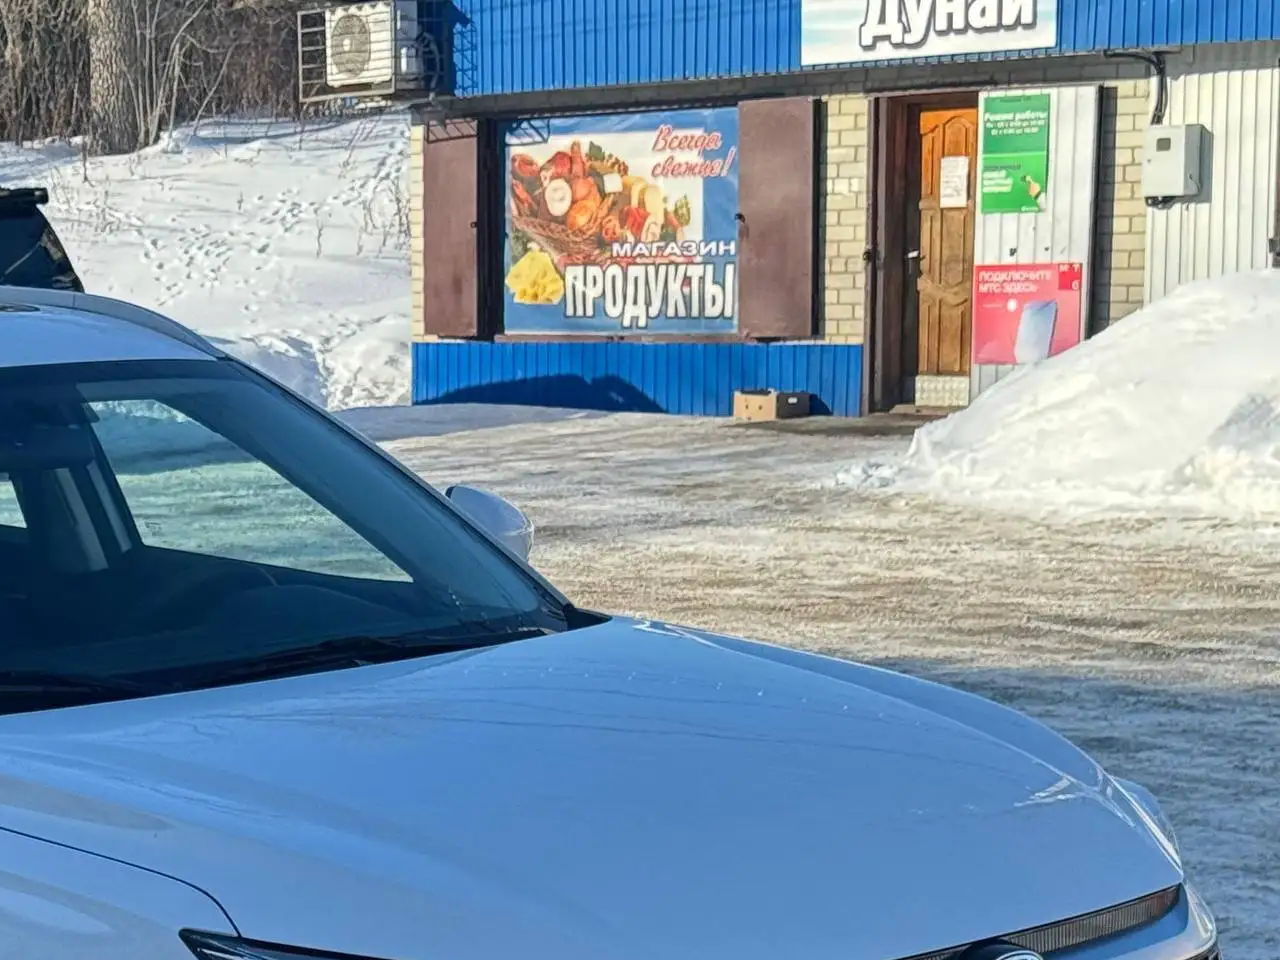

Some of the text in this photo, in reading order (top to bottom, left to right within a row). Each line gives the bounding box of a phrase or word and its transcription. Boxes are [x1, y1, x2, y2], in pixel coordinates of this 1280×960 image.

[651, 124, 723, 158] Всегда
[612, 240, 736, 257] МАГАЗИН
[565, 263, 735, 328] ПРОДУКТЫ
